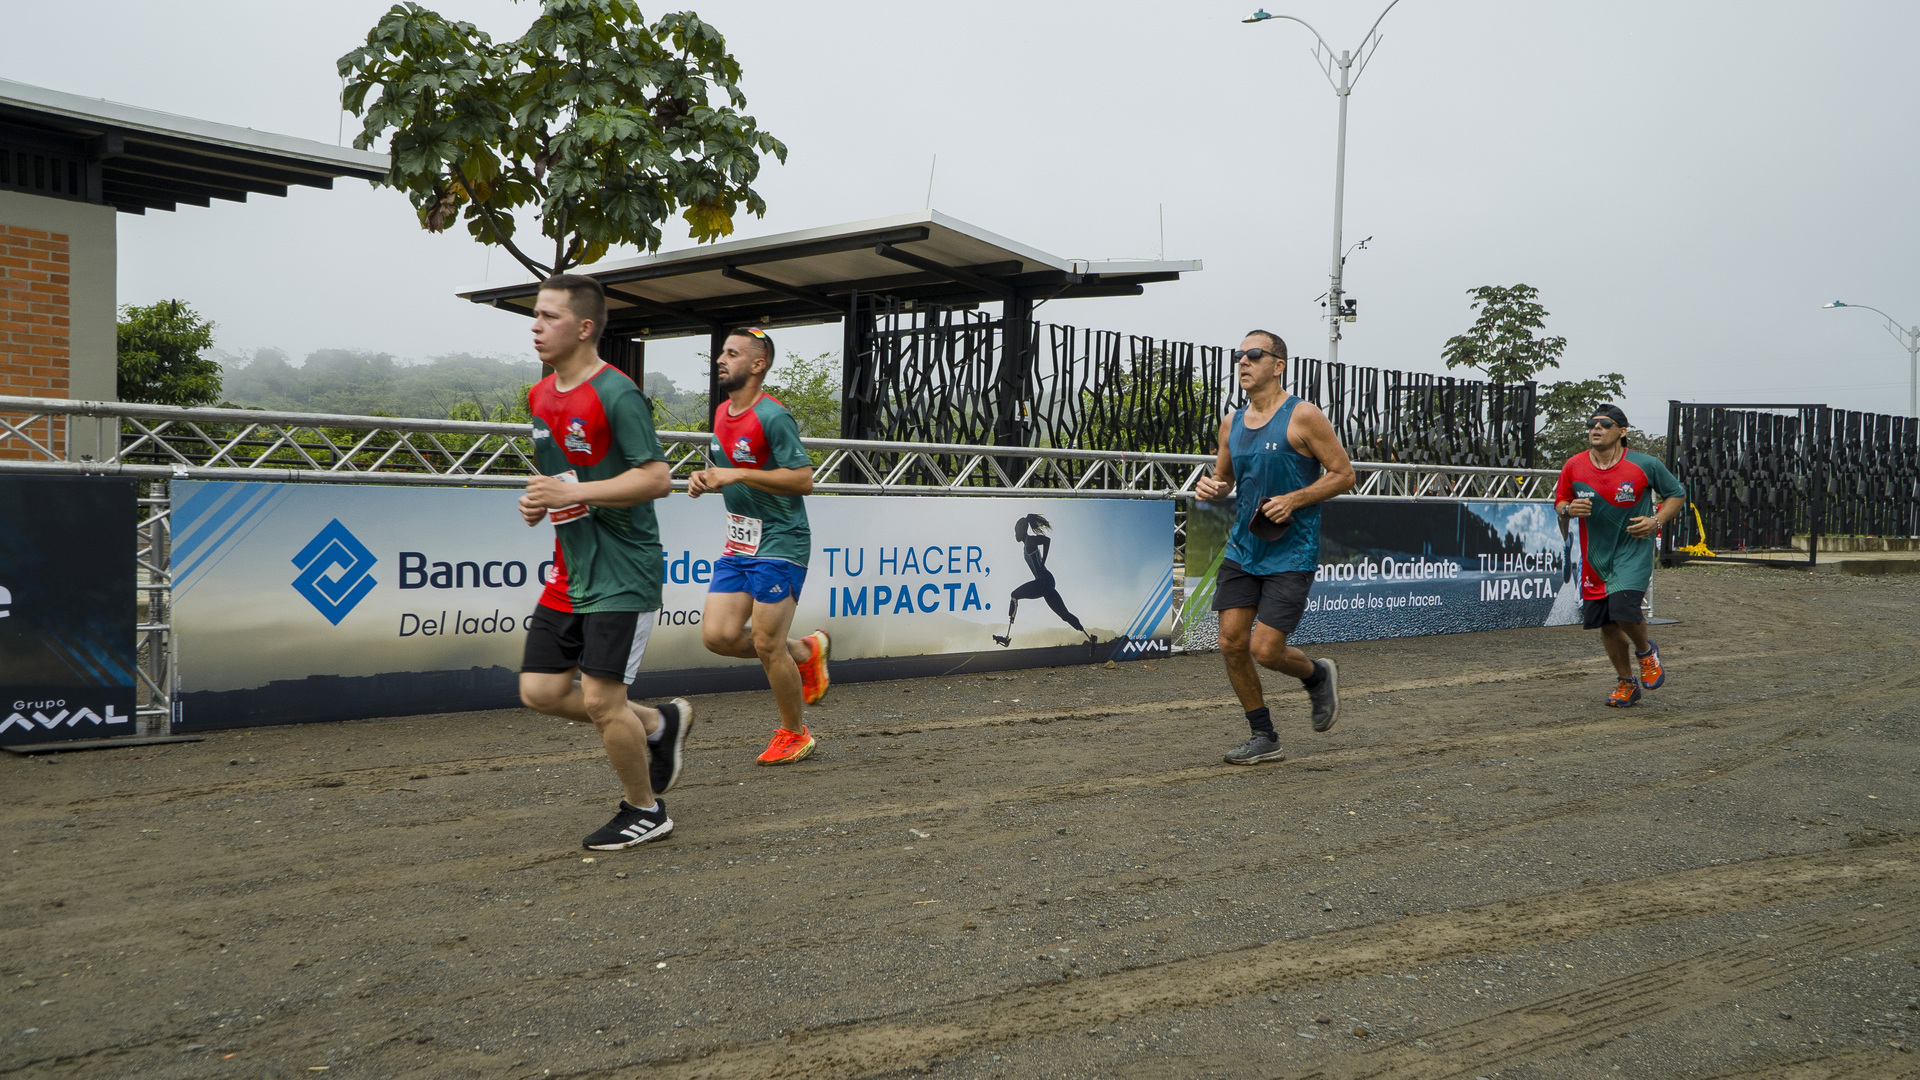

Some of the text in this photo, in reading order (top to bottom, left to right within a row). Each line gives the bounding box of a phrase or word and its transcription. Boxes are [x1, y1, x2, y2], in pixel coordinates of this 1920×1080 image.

[399, 551, 527, 589] Banco
[538, 551, 556, 586] d
[823, 545, 990, 577] TU HACER,
[1314, 556, 1458, 582] anco de Occidente
[1477, 552, 1557, 574] TU HACER,
[829, 582, 991, 617] IMPACTA.
[1323, 594, 1349, 611] lado
[1350, 593, 1365, 609] de
[1368, 592, 1383, 608] los
[1386, 596, 1406, 611] que
[1409, 591, 1443, 606] hacen.
[1480, 577, 1558, 601] IMPACTA.
[399, 610, 446, 637] Del
[455, 609, 515, 635] lado
[1123, 639, 1168, 653] AVAL
[13, 699, 66, 710] Grupo
[0, 705, 128, 733] AVAL
